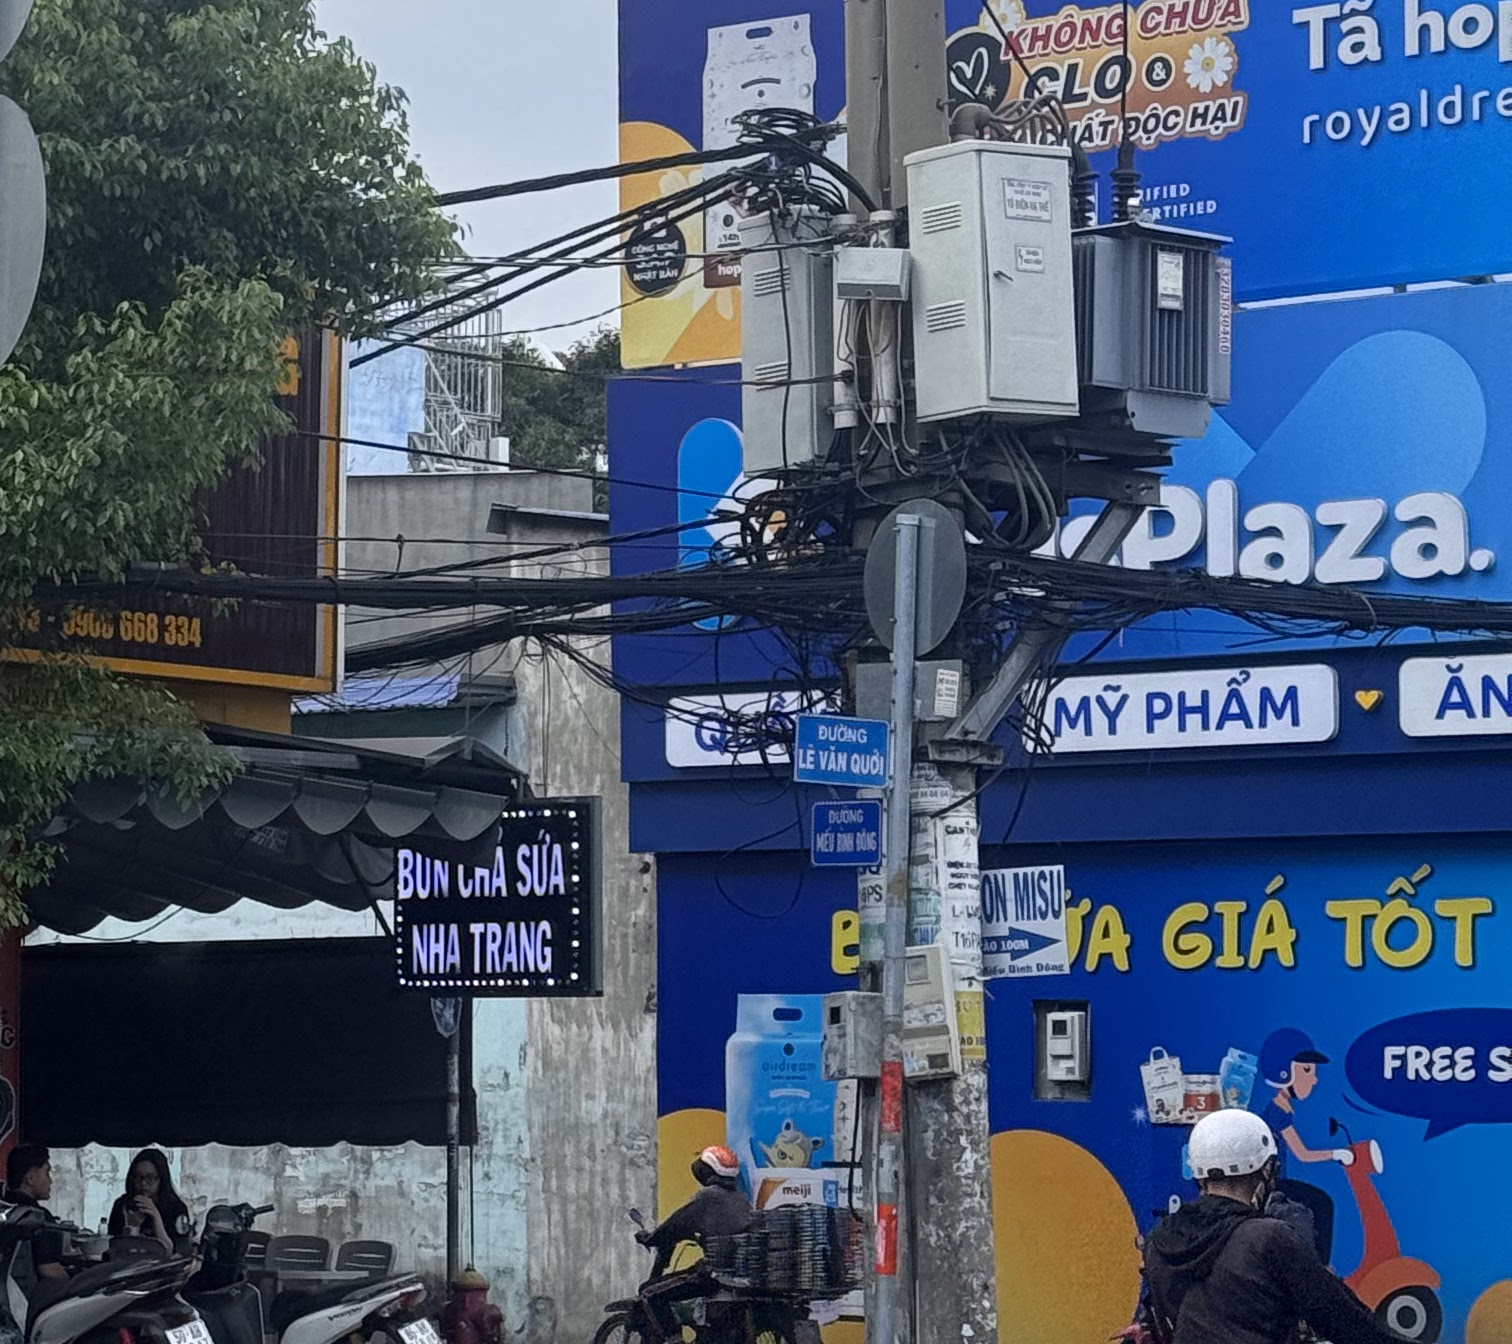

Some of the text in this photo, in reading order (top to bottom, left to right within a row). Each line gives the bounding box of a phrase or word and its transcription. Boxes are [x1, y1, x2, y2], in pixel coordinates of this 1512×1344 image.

[1003, 11, 1126, 58] KHÔNG
[1189, 99, 1240, 135] HẠI
[1136, 200, 1217, 219] ERTIFIED
[1058, 478, 1496, 586] Plaza.
[119, 610, 159, 644] 668
[164, 615, 202, 648] 334
[1053, 669, 1301, 738] MỸ PHẨM
[1434, 662, 1512, 720] ĂN
[818, 722, 868, 744] ĐƯỜNG
[798, 744, 816, 770] LÊ
[819, 746, 848, 773] VĂN
[516, 829, 566, 897] SỨA
[1012, 869, 1062, 922] MISU
[1161, 874, 1297, 970] GIÁ
[1325, 863, 1493, 968] TỐT
[412, 920, 553, 975] NHA TRANG
[1383, 1045, 1476, 1082] FREE
[782, 1183, 812, 1199] meiji
